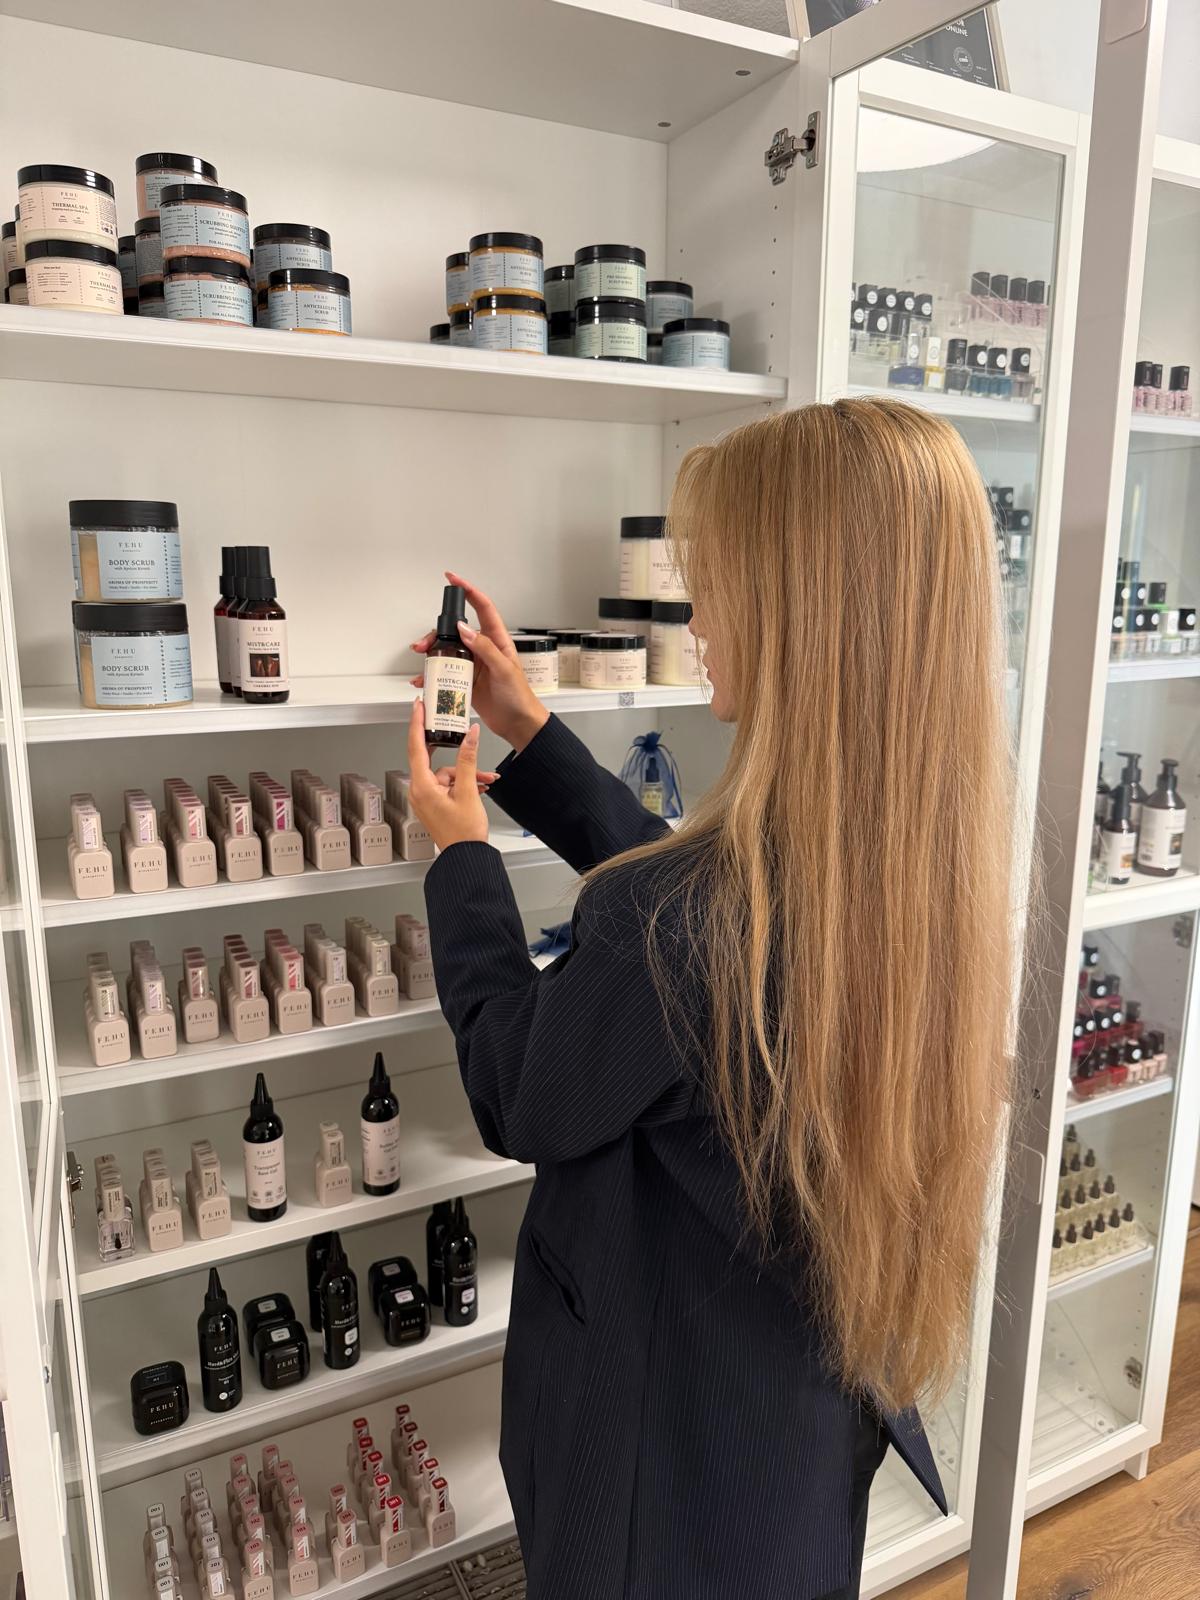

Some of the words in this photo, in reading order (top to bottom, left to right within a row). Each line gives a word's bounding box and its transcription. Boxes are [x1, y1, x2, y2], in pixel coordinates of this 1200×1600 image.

[200, 219, 229, 229] SCRUBBING
[436, 677, 470, 687] MIST&CARE
[322, 841, 348, 849] FEHU
[364, 836, 389, 844] FEHU
[231, 851, 258, 859] FEHU
[134, 860, 163, 868] FEHU
[78, 865, 108, 874] FEHU
[372, 988, 395, 996] FEHU
[327, 996, 352, 1005] FEHU
[283, 1003, 309, 1012] FEHU
[188, 1011, 215, 1021] FEHU
[240, 1011, 265, 1020] FEHU
[144, 1025, 173, 1035] FEHU
[97, 1032, 126, 1044] FEHU
[326, 1176, 350, 1188] FEHU
[201, 1209, 228, 1220] FEHU
[152, 1221, 179, 1232] FEHU
[276, 1357, 298, 1369] FEHU
[150, 1402, 174, 1413] FEHU
[388, 1540, 408, 1551] FEHU
[341, 1553, 361, 1567] FEHU
[292, 1568, 316, 1580] FEHU
[247, 1584, 272, 1598] FEHU
